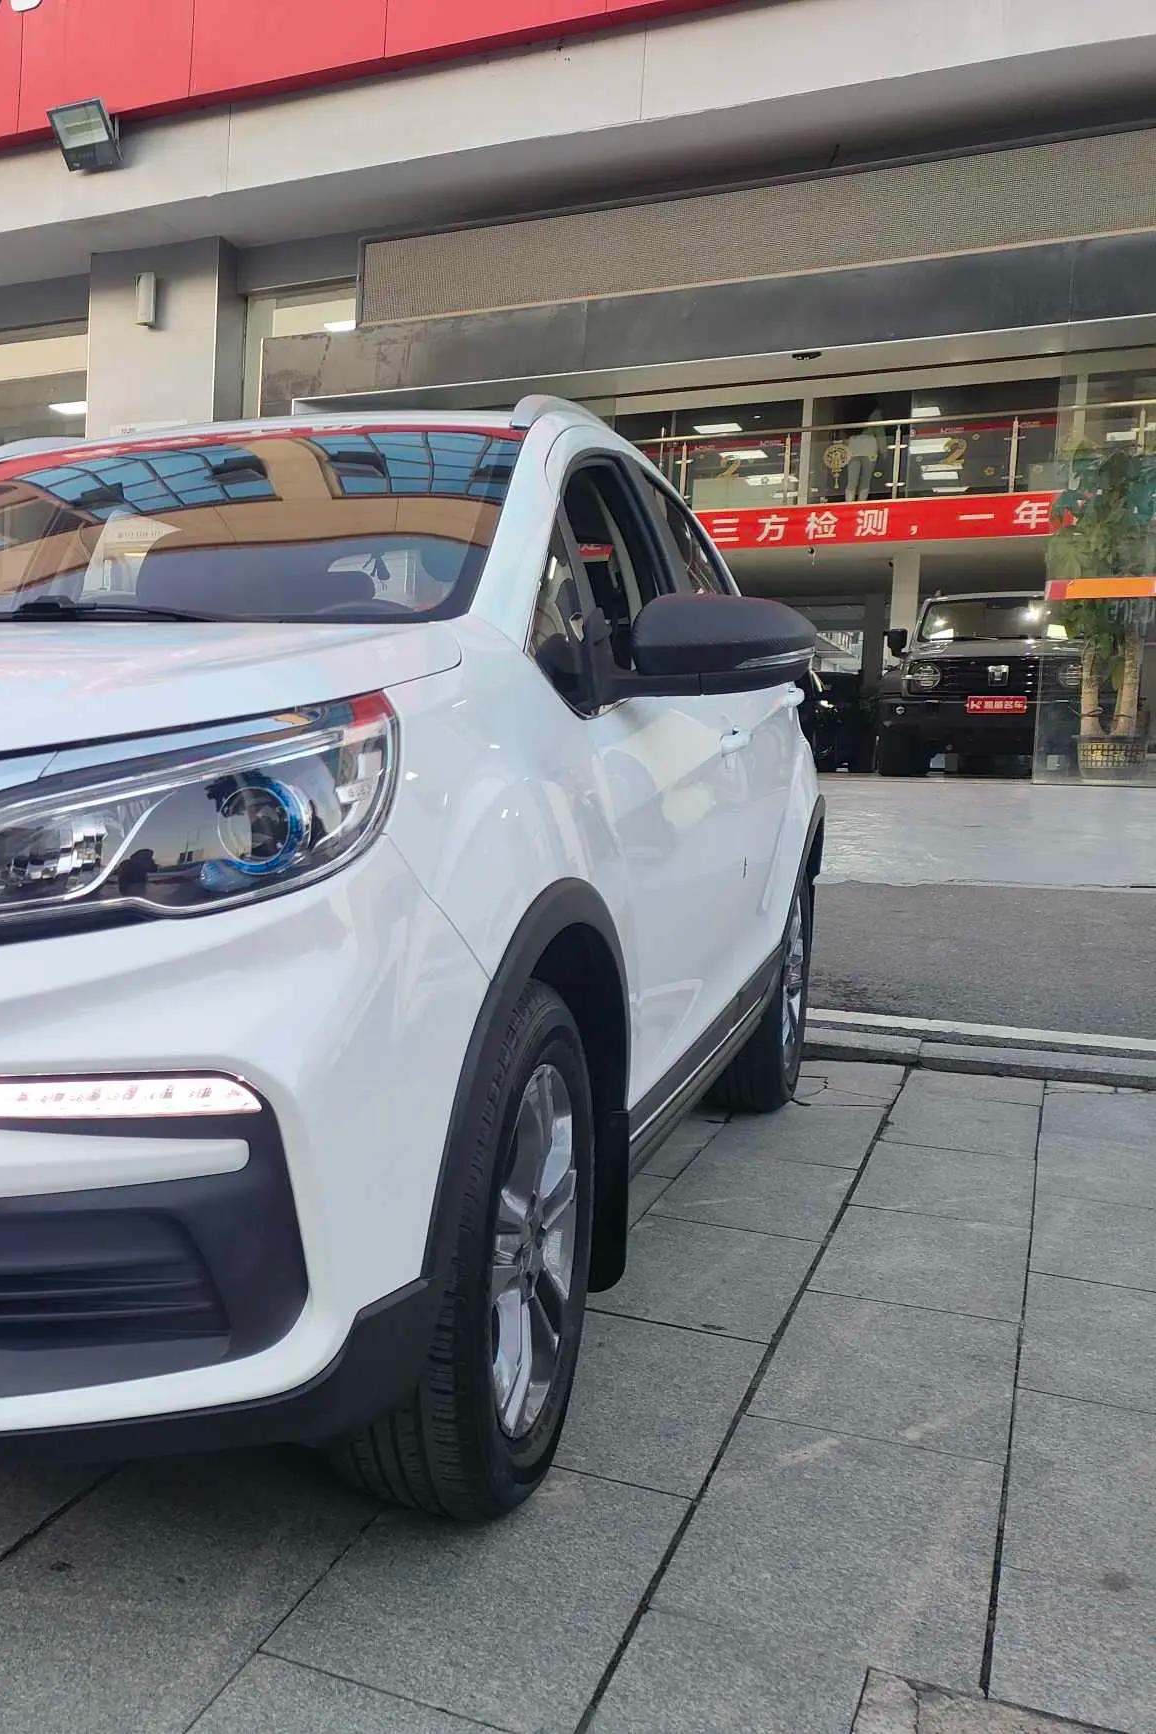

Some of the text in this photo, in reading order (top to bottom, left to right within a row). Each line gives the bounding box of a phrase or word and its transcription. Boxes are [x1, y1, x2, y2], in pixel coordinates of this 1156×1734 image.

[711, 500, 1050, 543] 三方检测，一年
